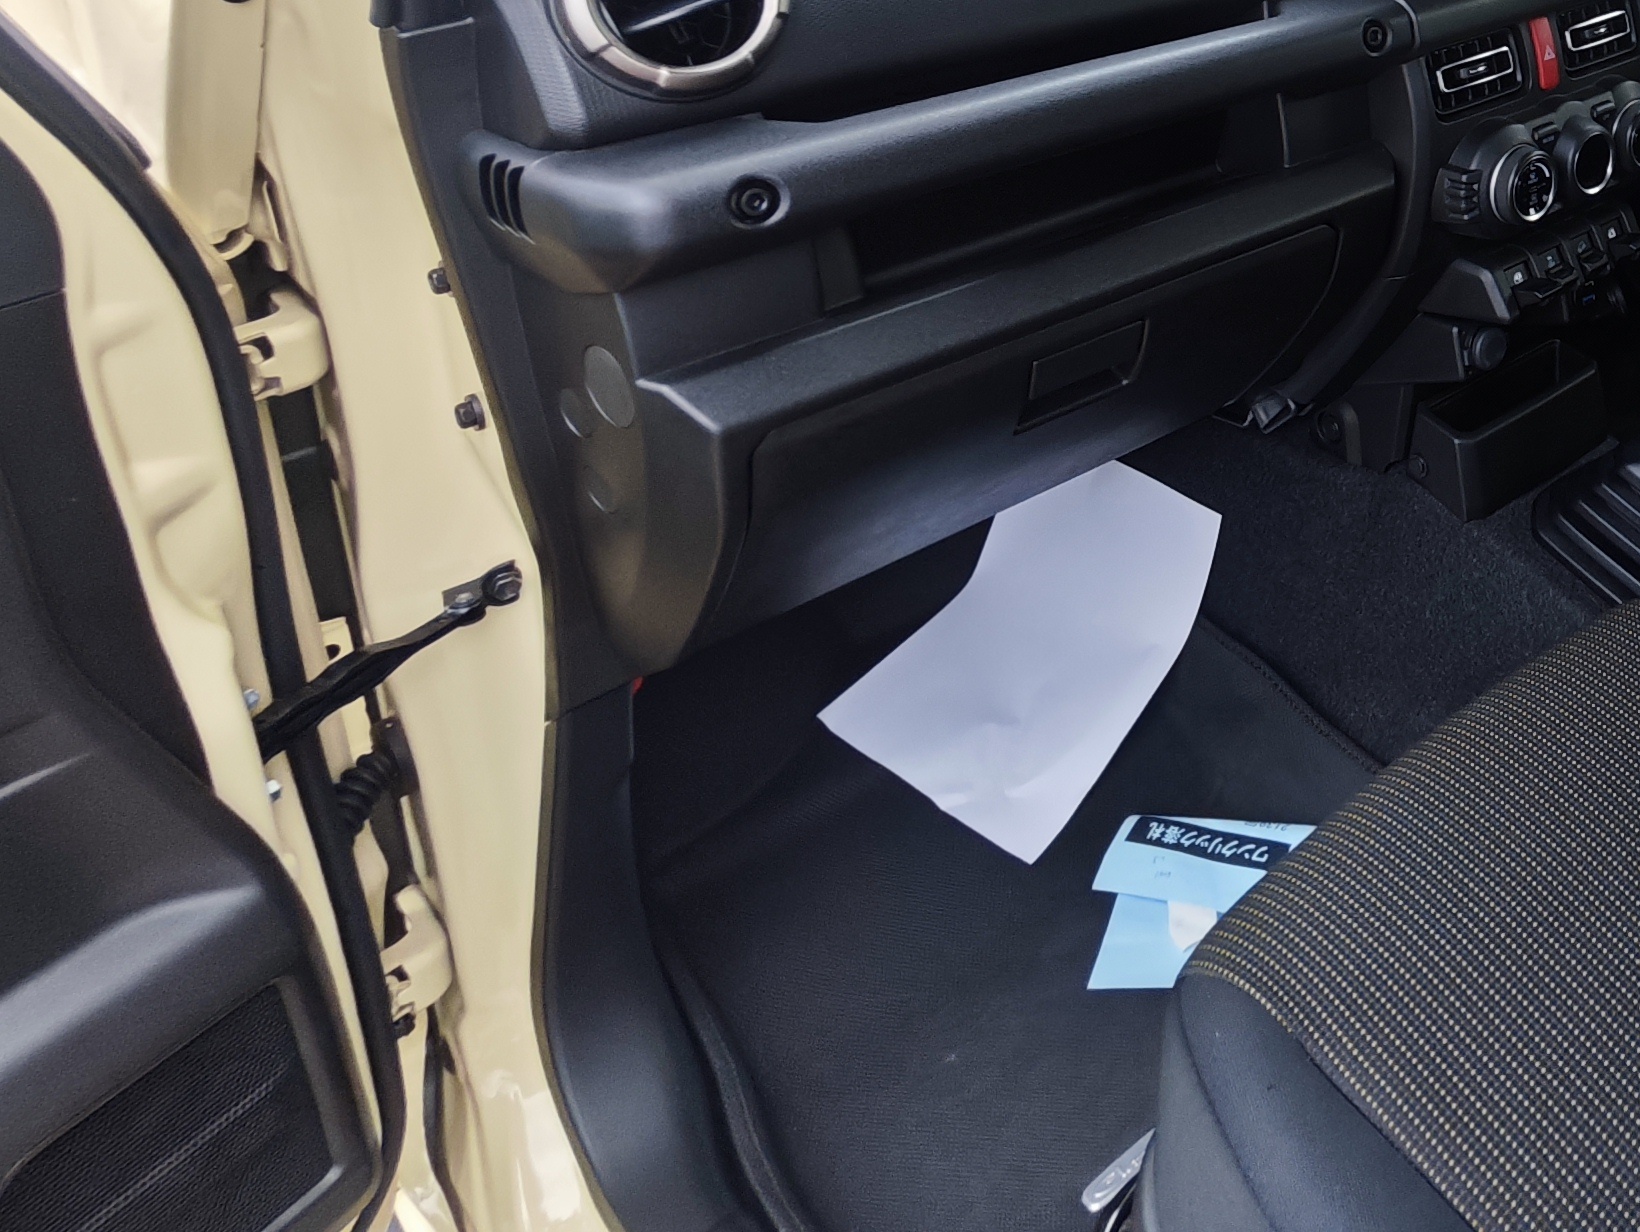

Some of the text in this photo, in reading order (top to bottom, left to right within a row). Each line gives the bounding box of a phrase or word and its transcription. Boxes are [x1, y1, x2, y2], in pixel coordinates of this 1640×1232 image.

[1145, 821, 1270, 863] ワンクリック落札
